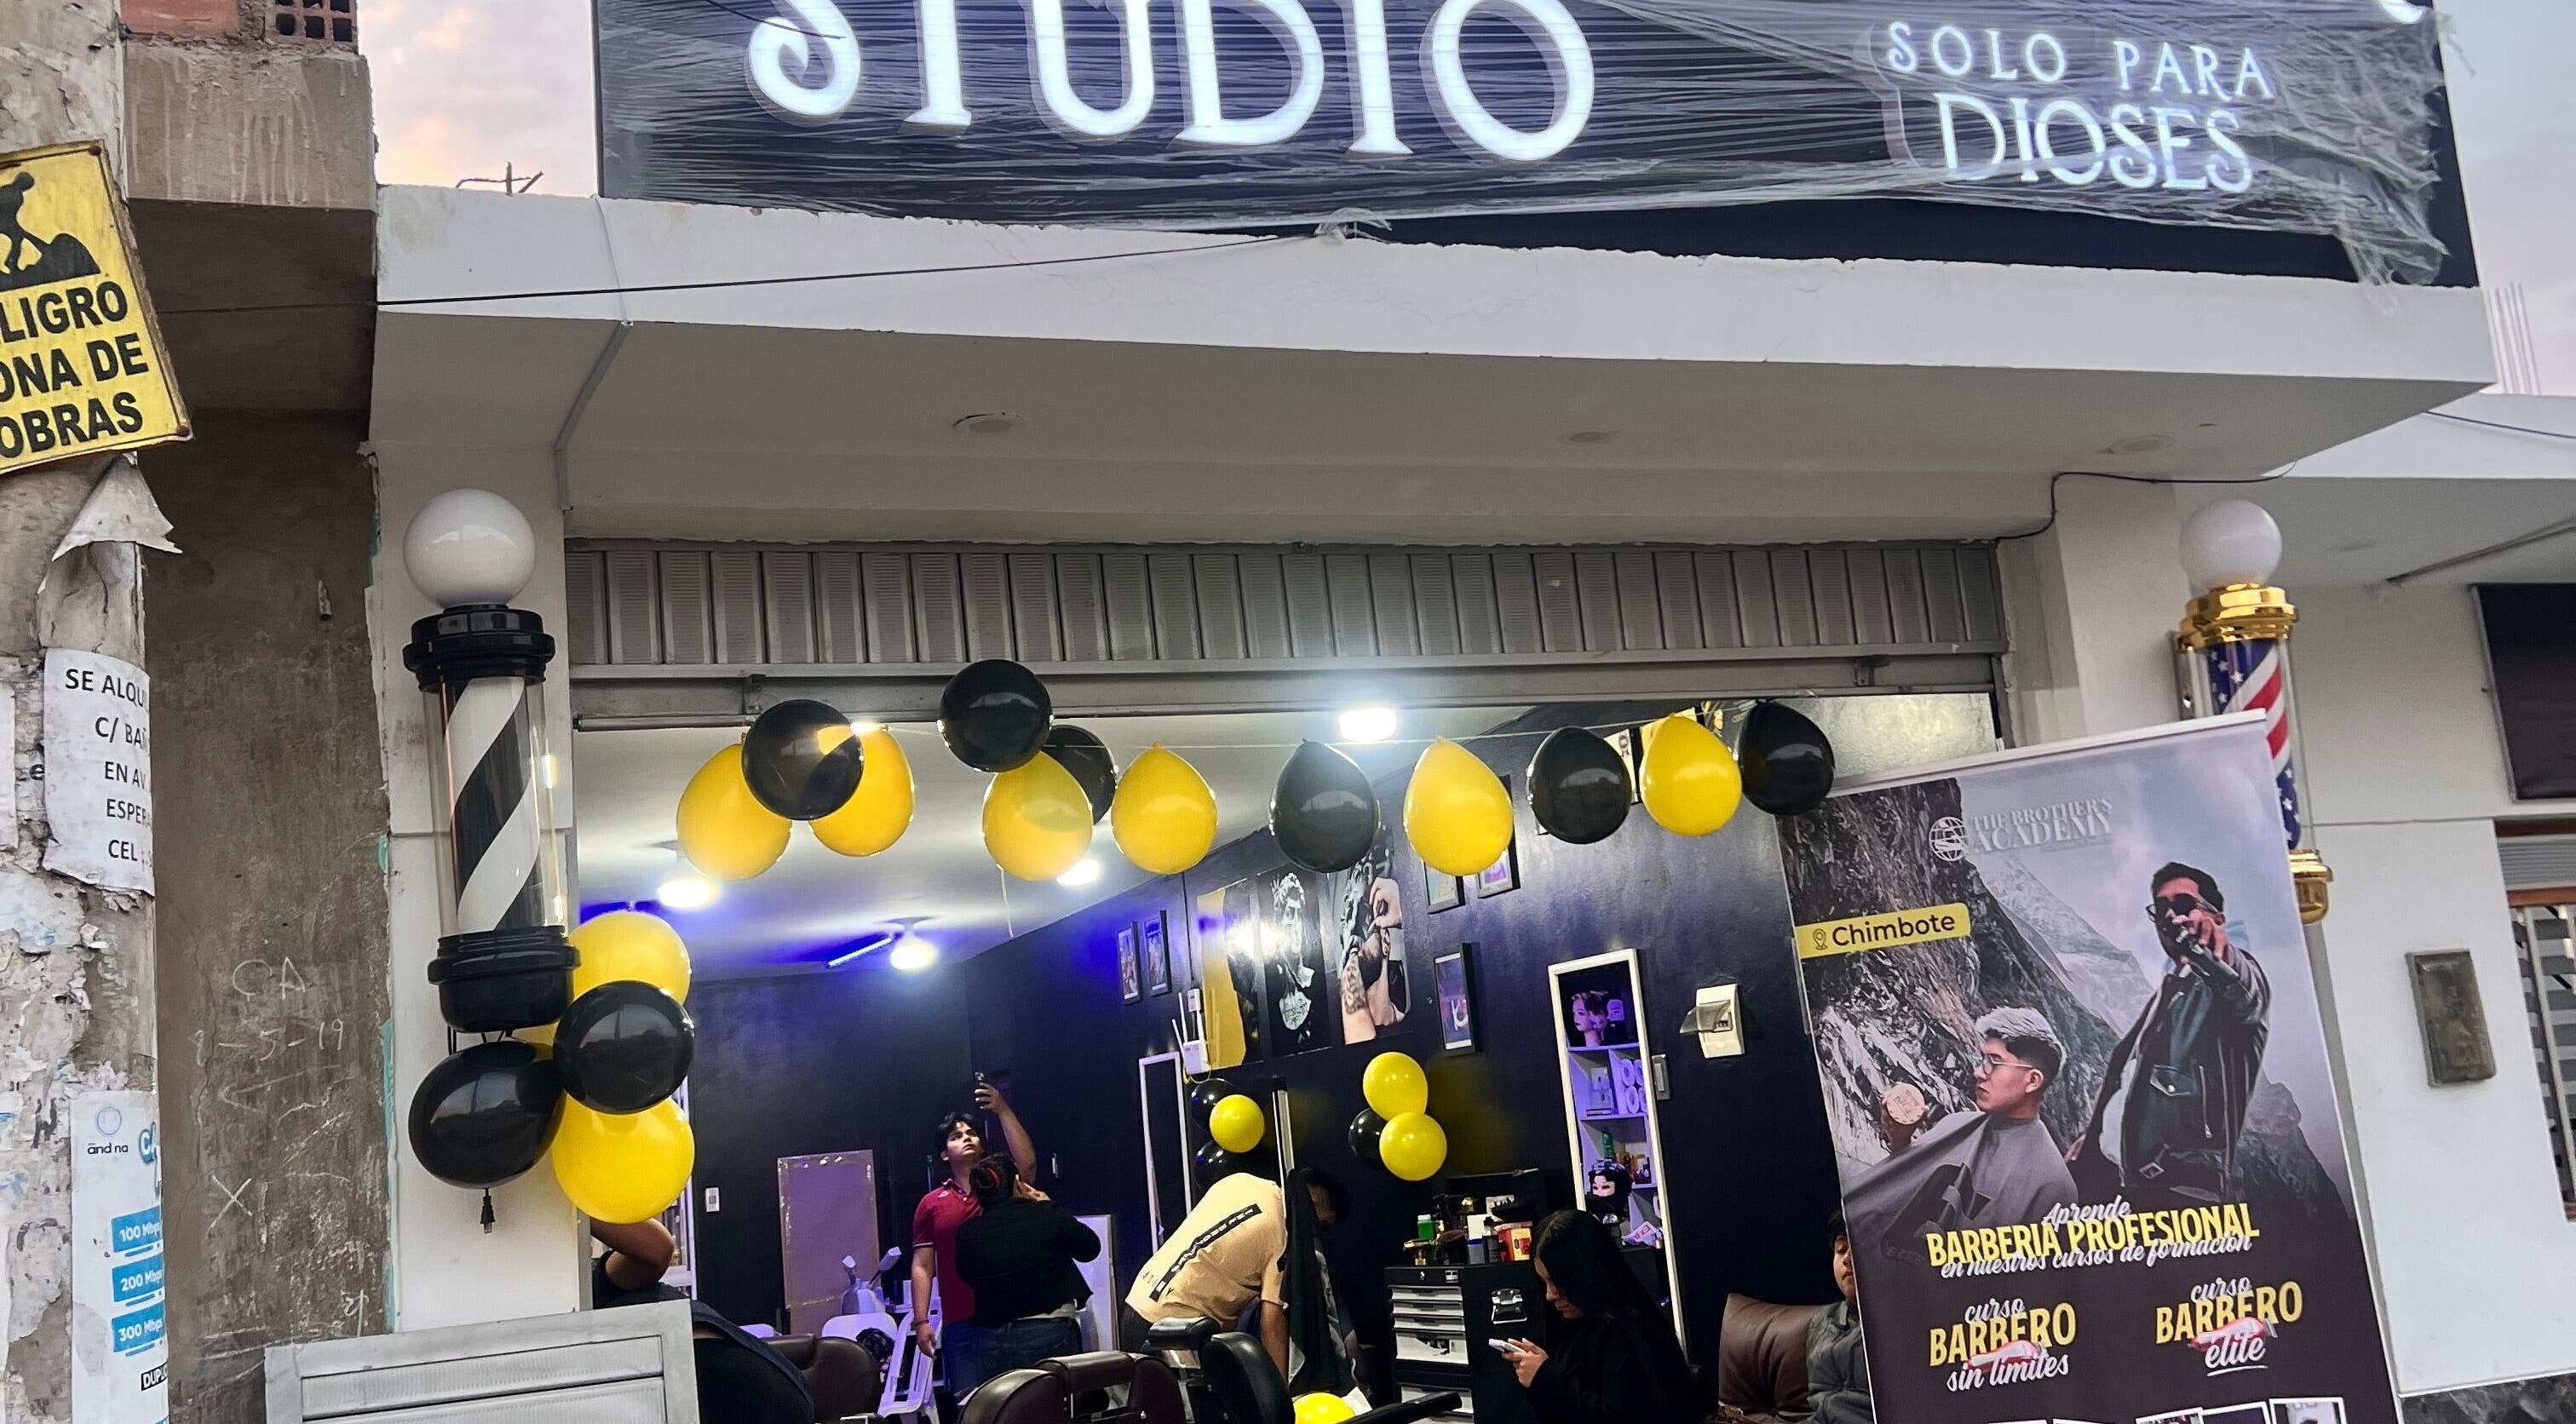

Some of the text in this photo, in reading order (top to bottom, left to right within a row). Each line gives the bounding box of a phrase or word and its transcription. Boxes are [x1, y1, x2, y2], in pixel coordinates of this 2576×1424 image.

[1888, 20, 2275, 102] SOLO PARA
[746, 0, 1595, 162] STUDIO
[1933, 91, 2254, 194] DIOSES
[86, 332, 150, 382] DE
[0, 392, 143, 458] OBRAS
[65, 669, 94, 692] SE
[95, 717, 119, 744] C/
[105, 761, 128, 784] EN
[1970, 811, 2007, 832] THE
[1970, 812, 2113, 853] ACADEMY
[1831, 914, 1956, 947] Chimbote
[2041, 1194, 2131, 1232] Aprende
[2067, 1203, 2260, 1253] PROFESIONAL
[119, 1225, 141, 1242] 100
[1941, 1260, 1964, 1278] en
[1967, 1248, 2046, 1276] nuestros
[2052, 1247, 2114, 1269] cursos
[2119, 1240, 2145, 1263] de
[120, 1274, 143, 1291] 200
[2191, 1277, 2253, 1304] curso
[1964, 1298, 2026, 1324] curso
[2156, 1281, 2303, 1345] BARBERO
[118, 1323, 142, 1342] 300
[1929, 1302, 2077, 1366] BARBERO
[1946, 1363, 1985, 1392] sin
